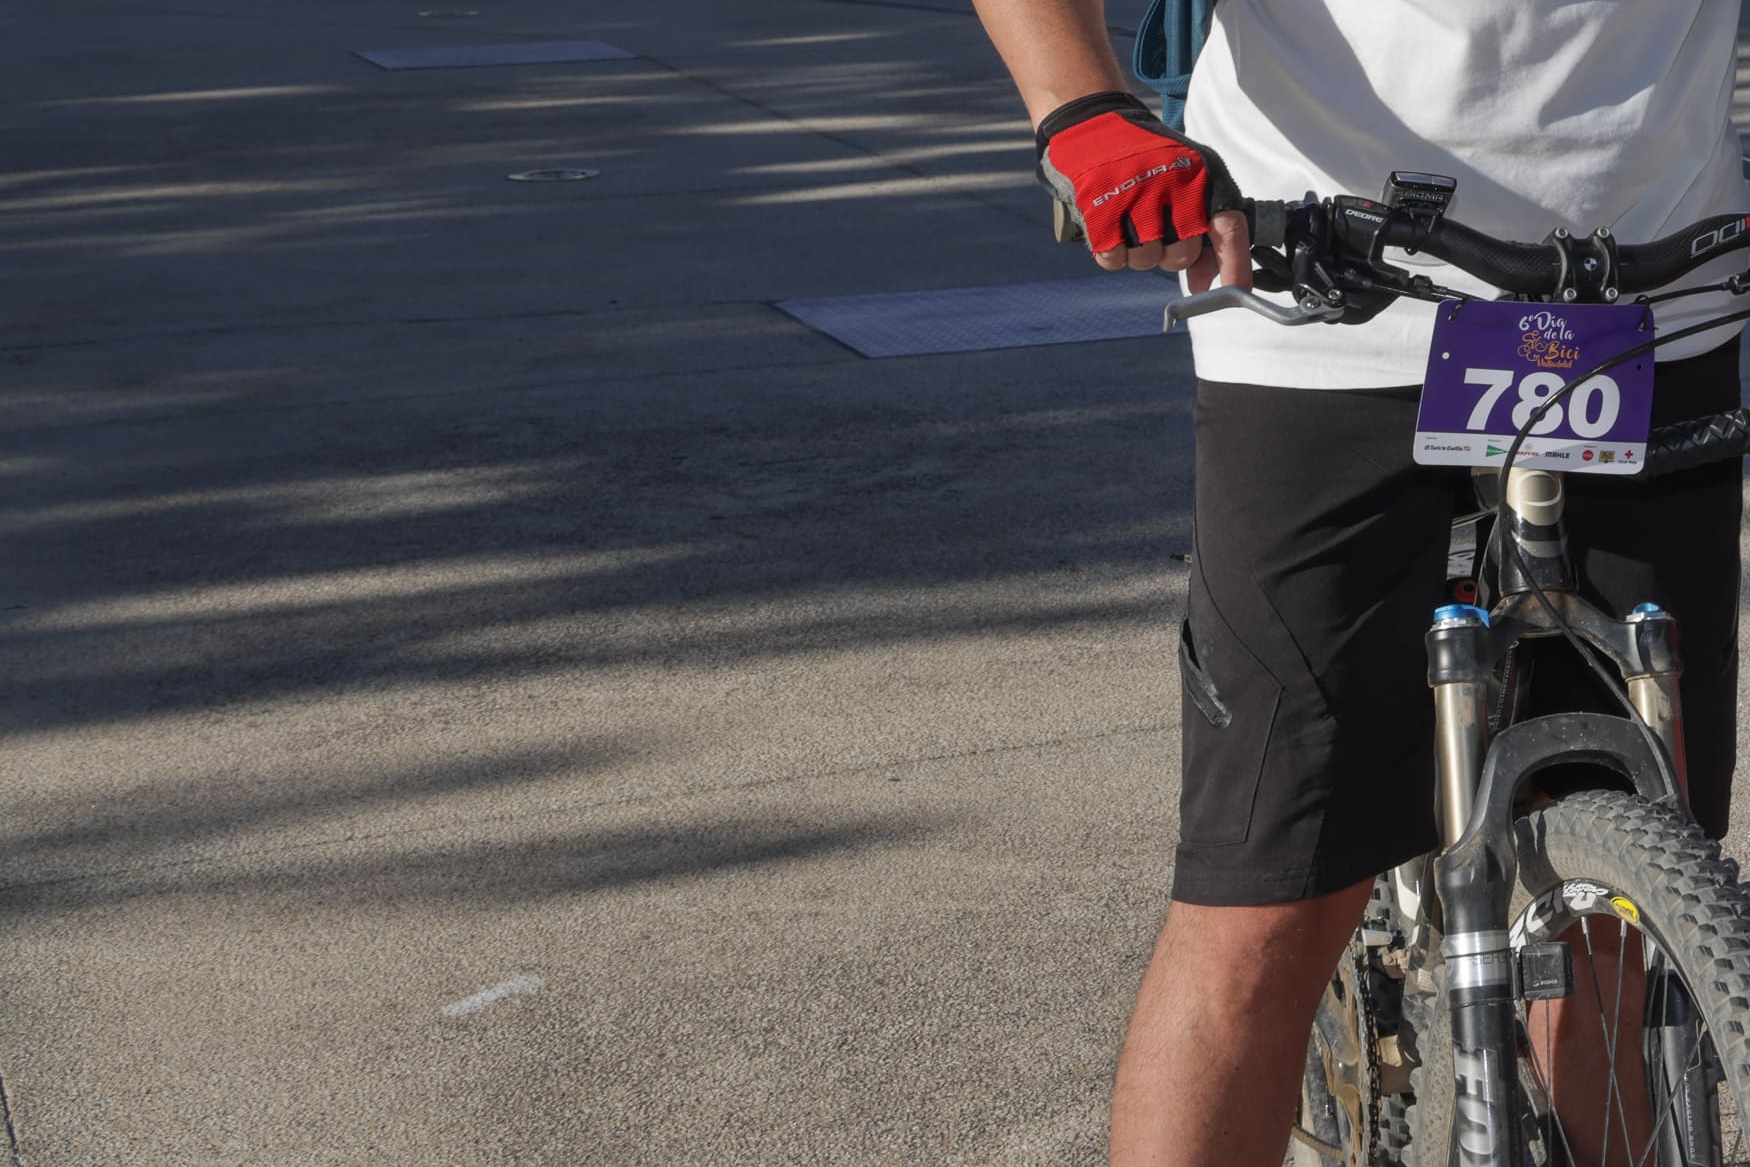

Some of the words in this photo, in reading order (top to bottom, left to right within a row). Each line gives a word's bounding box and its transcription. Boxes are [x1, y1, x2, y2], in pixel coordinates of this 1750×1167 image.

[1092, 161, 1184, 207] ENDURA
[1345, 208, 1384, 223] DEORE
[1544, 341, 1580, 360] Bici
[1463, 367, 1621, 439] 780
[1454, 1047, 1498, 1167] FO
